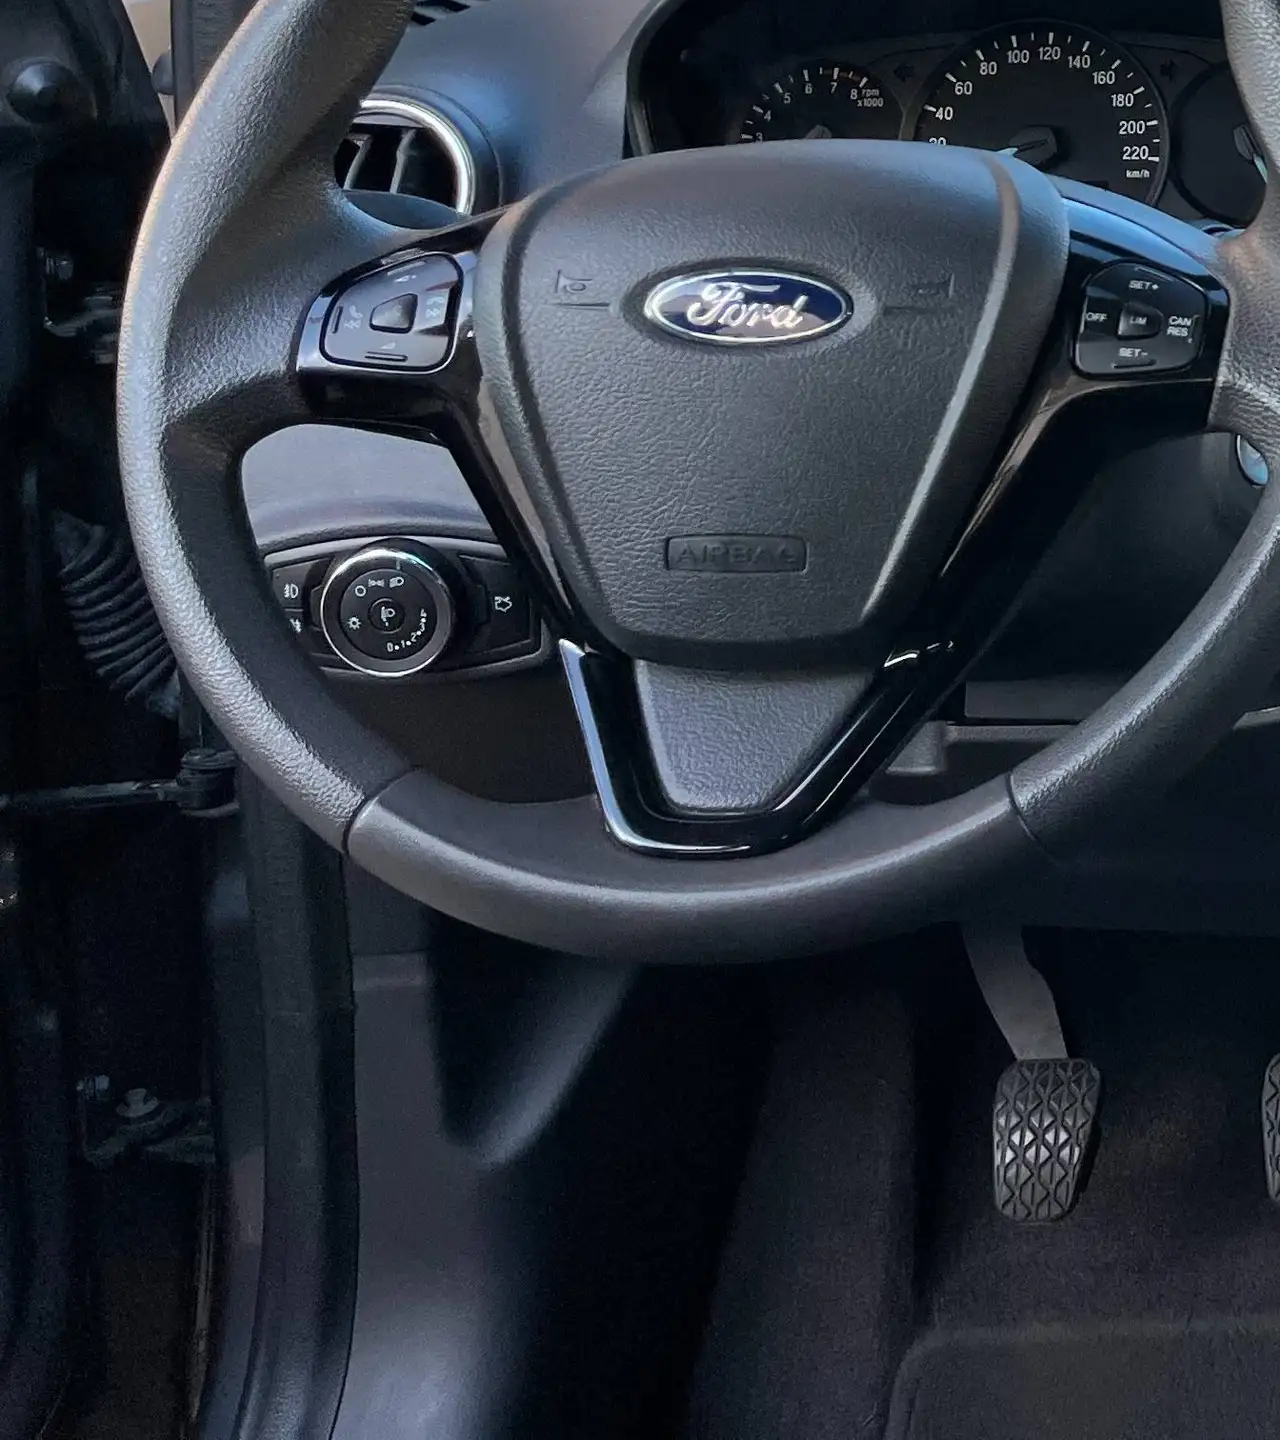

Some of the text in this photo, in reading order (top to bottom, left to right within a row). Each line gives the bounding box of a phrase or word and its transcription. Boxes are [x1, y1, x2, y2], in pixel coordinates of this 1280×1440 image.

[1007, 49, 1030, 63] 100
[1038, 46, 1061, 60] 120
[979, 61, 998, 75] 80
[1068, 54, 1091, 69] 140
[1092, 70, 1116, 85] 160
[804, 83, 813, 95] 6
[829, 81, 838, 94] 7
[850, 88, 858, 100] 8
[862, 88, 880, 98] rpm
[954, 81, 973, 95] 60
[783, 93, 791, 104] 5
[1111, 93, 1134, 107] 180
[764, 110, 772, 122] 4
[935, 106, 954, 121] 40
[1119, 120, 1146, 135] 200
[1122, 146, 1149, 160] 220
[1126, 169, 1150, 178] km/h
[686, 281, 809, 328] Ford
[1086, 312, 1108, 322] OFF
[1168, 316, 1192, 326] CAN
[1166, 326, 1189, 337] RES
